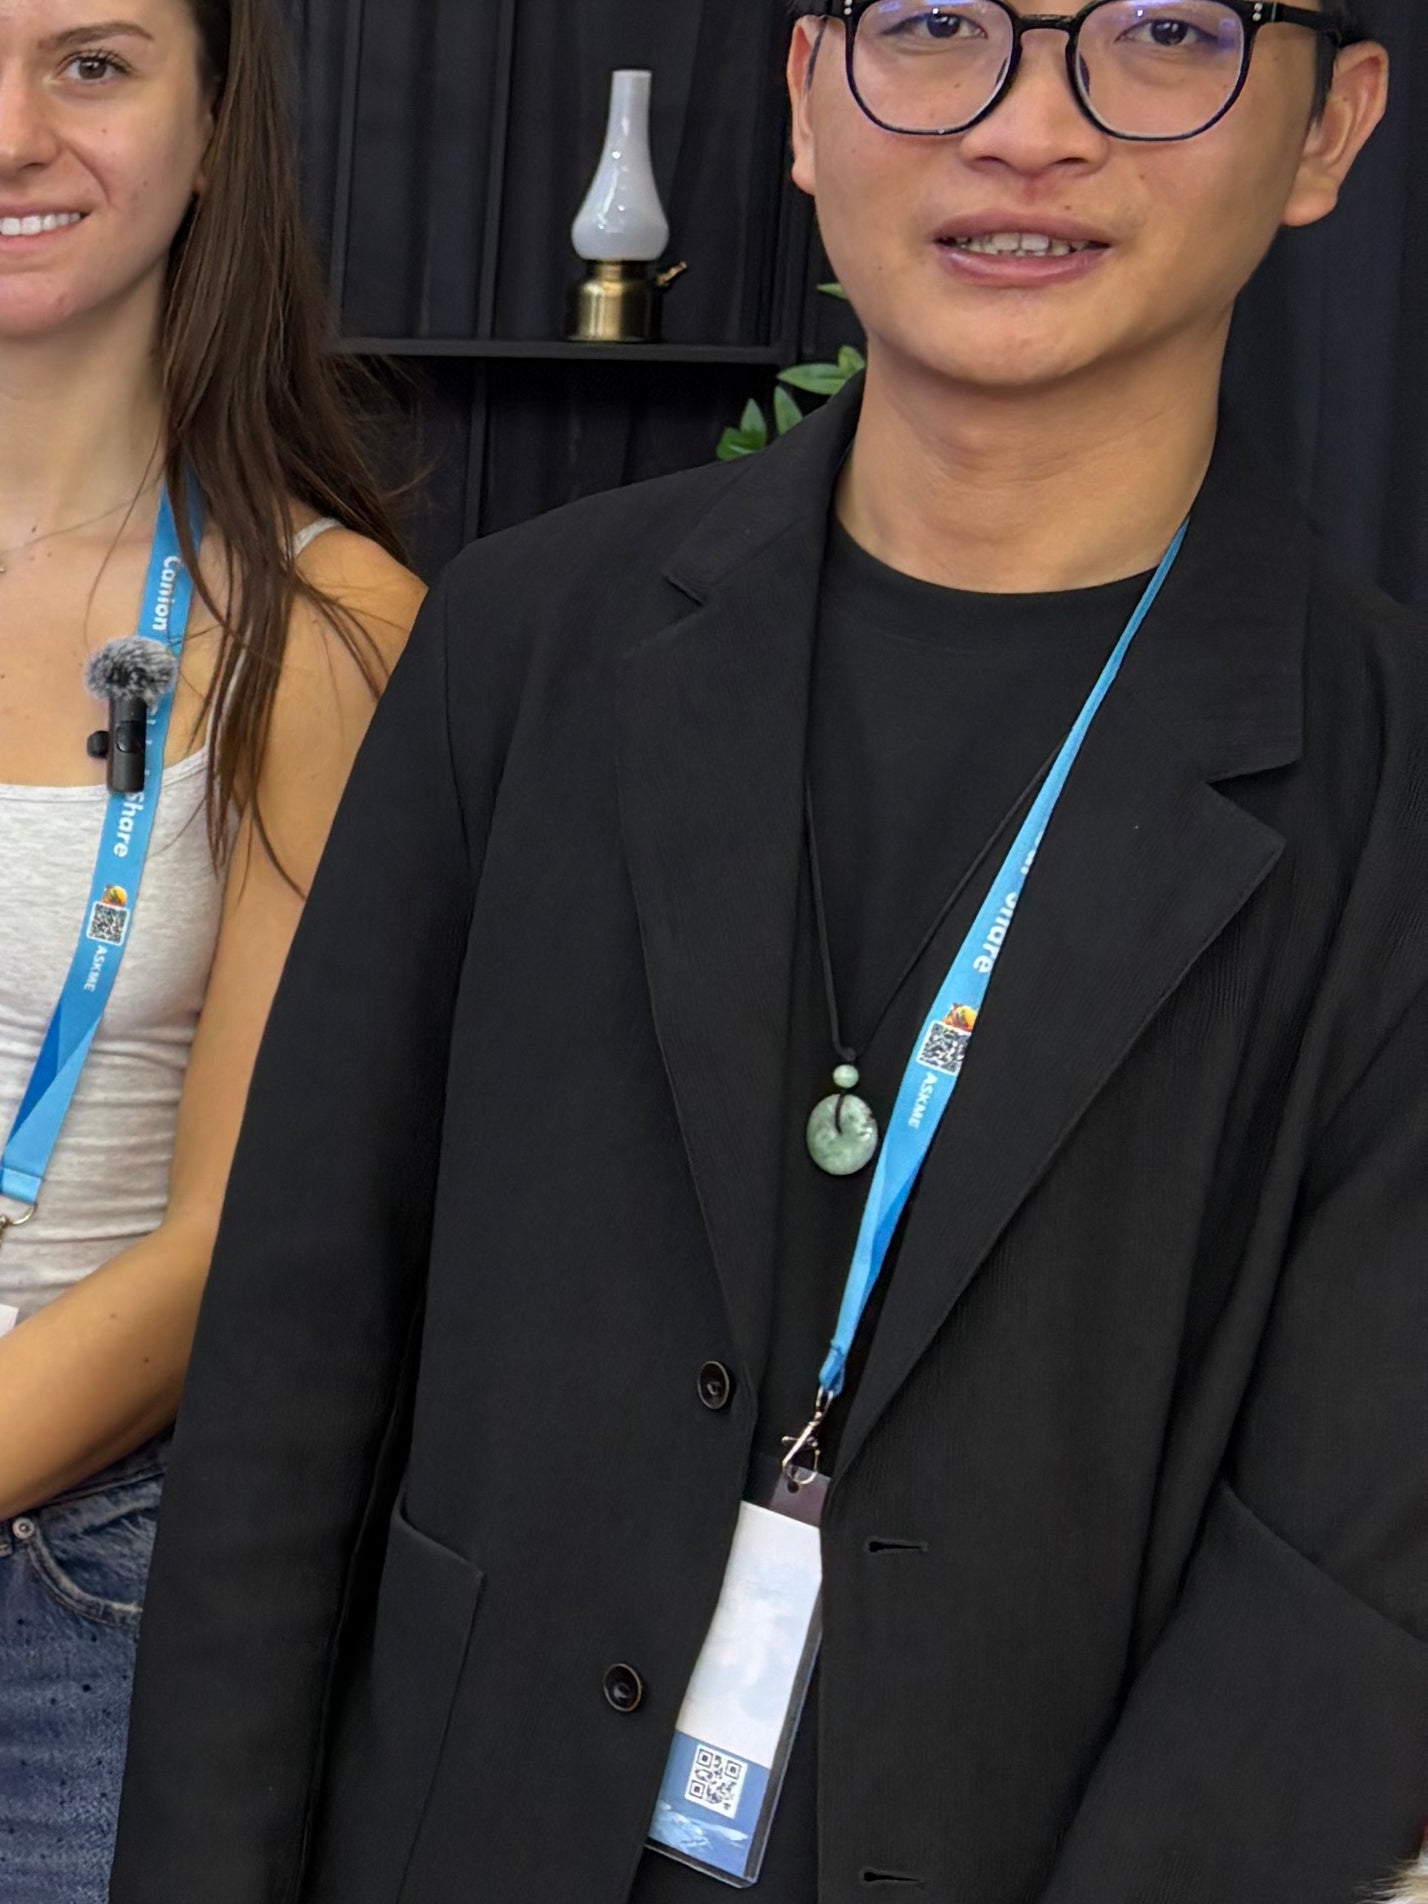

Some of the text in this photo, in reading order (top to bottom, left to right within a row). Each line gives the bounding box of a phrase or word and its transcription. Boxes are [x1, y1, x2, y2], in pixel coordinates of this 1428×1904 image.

[152, 555, 183, 631] Canton
[85, 945, 110, 992] ASKME
[908, 1071, 938, 1129] ASKME
